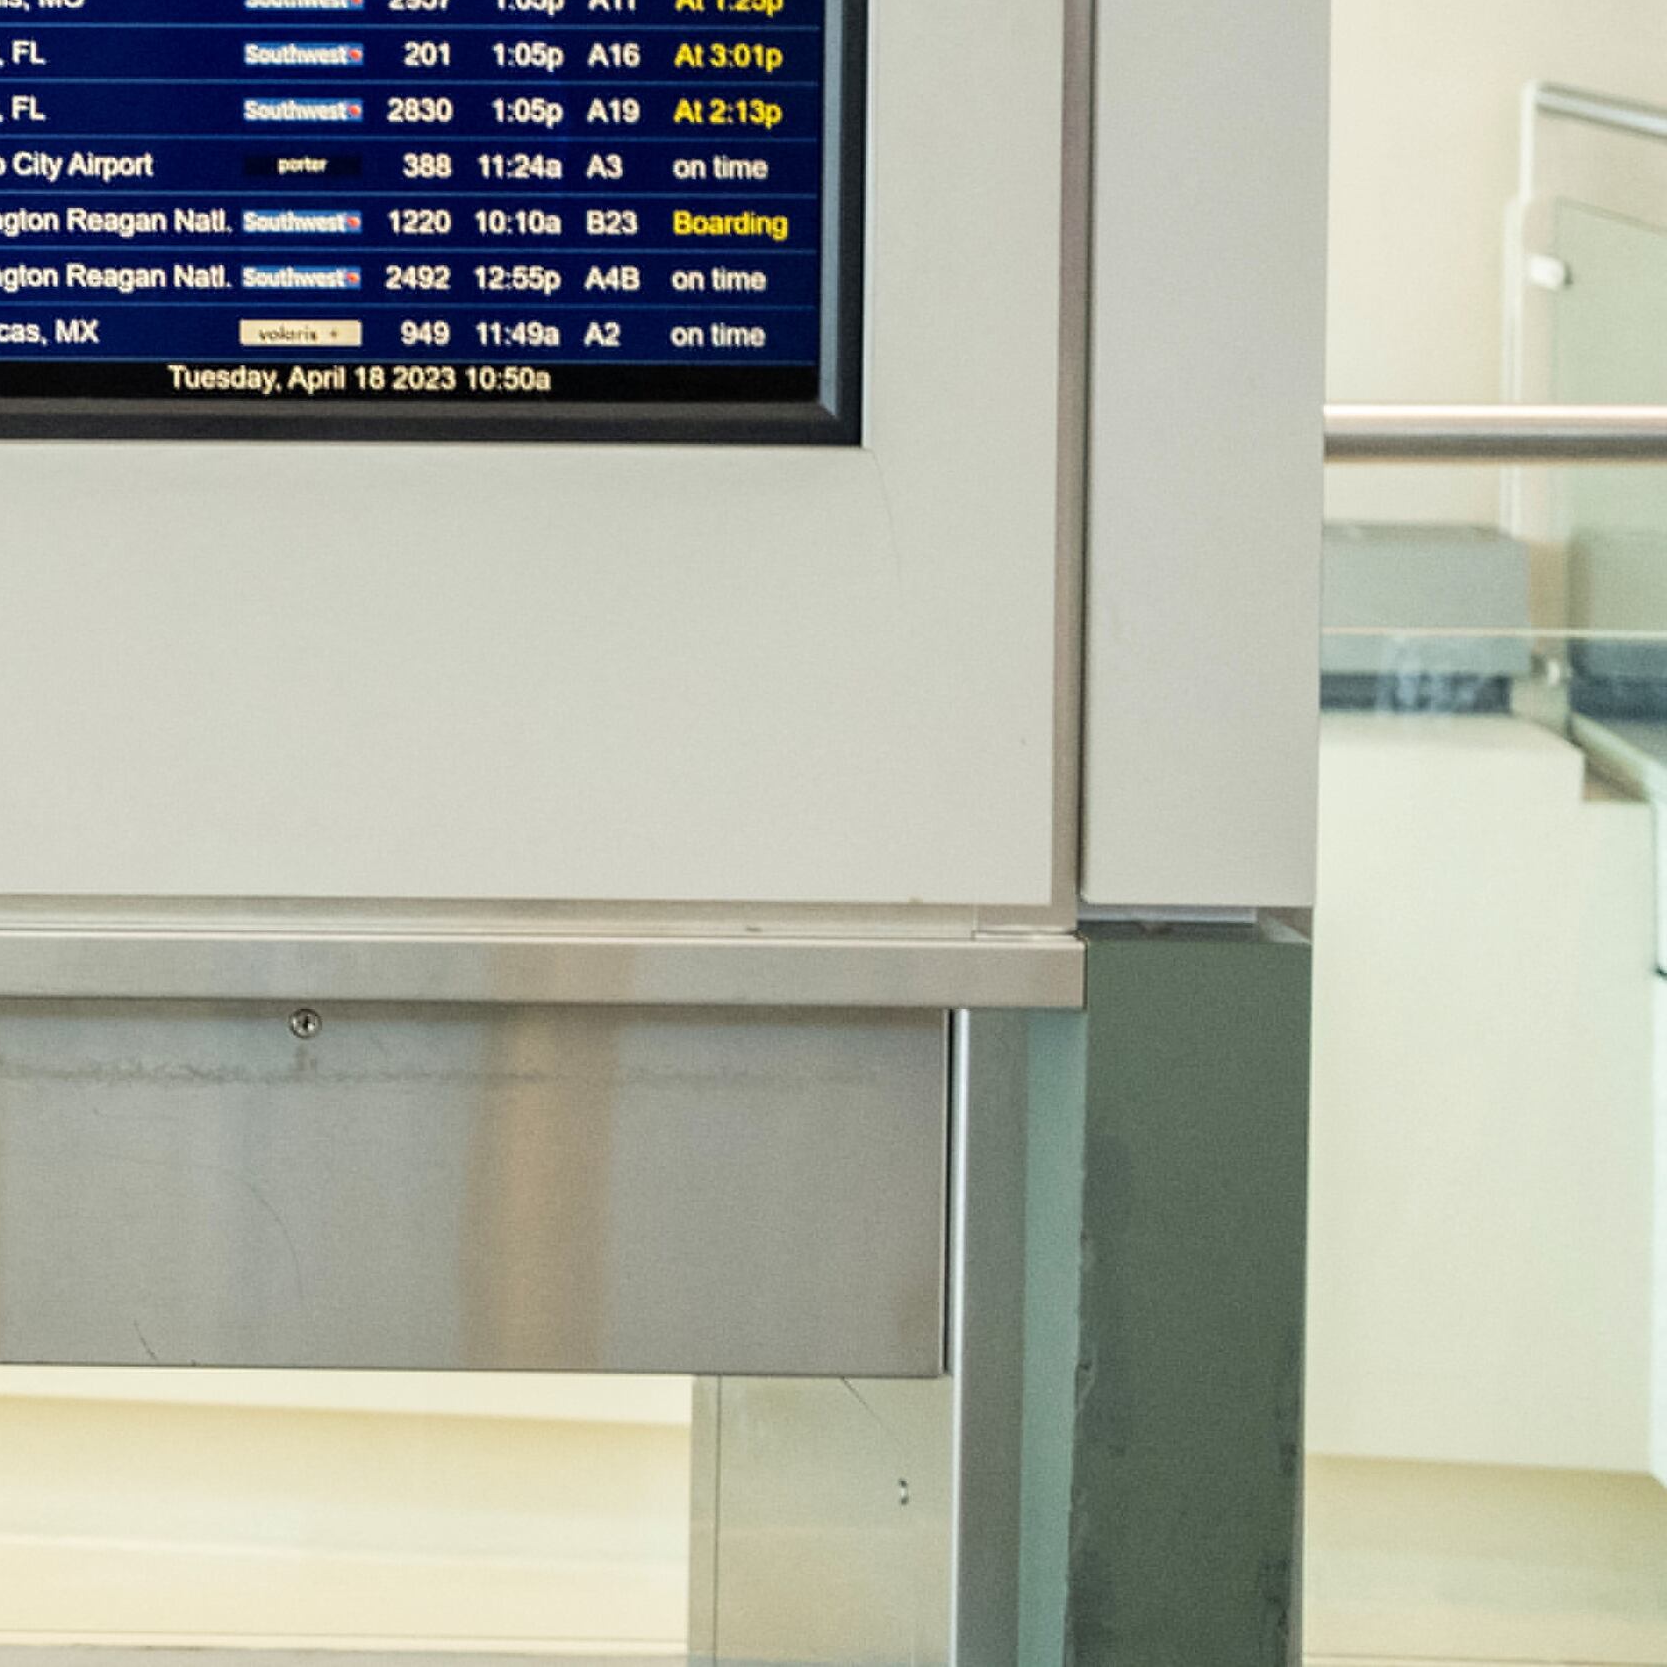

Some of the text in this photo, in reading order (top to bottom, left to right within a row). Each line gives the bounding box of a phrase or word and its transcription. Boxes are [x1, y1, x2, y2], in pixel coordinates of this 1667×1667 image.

[12, 150, 64, 183] City
[67, 151, 154, 183] Airport
[278, 157, 327, 174] porter
[402, 152, 452, 178] 388
[478, 153, 563, 179] 11:24a
[586, 154, 624, 179] A3
[672, 158, 707, 180] on
[712, 155, 769, 180] time
[66, 207, 168, 238] Reagan
[174, 207, 233, 233] Natl.
[243, 211, 347, 232] Southwest
[388, 209, 452, 234] 1220
[475, 209, 562, 235] 10:10a
[586, 209, 638, 235] B23
[672, 210, 788, 241] Boarding
[167, 364, 552, 395] Tuesday, April 18 2023 10:50a
